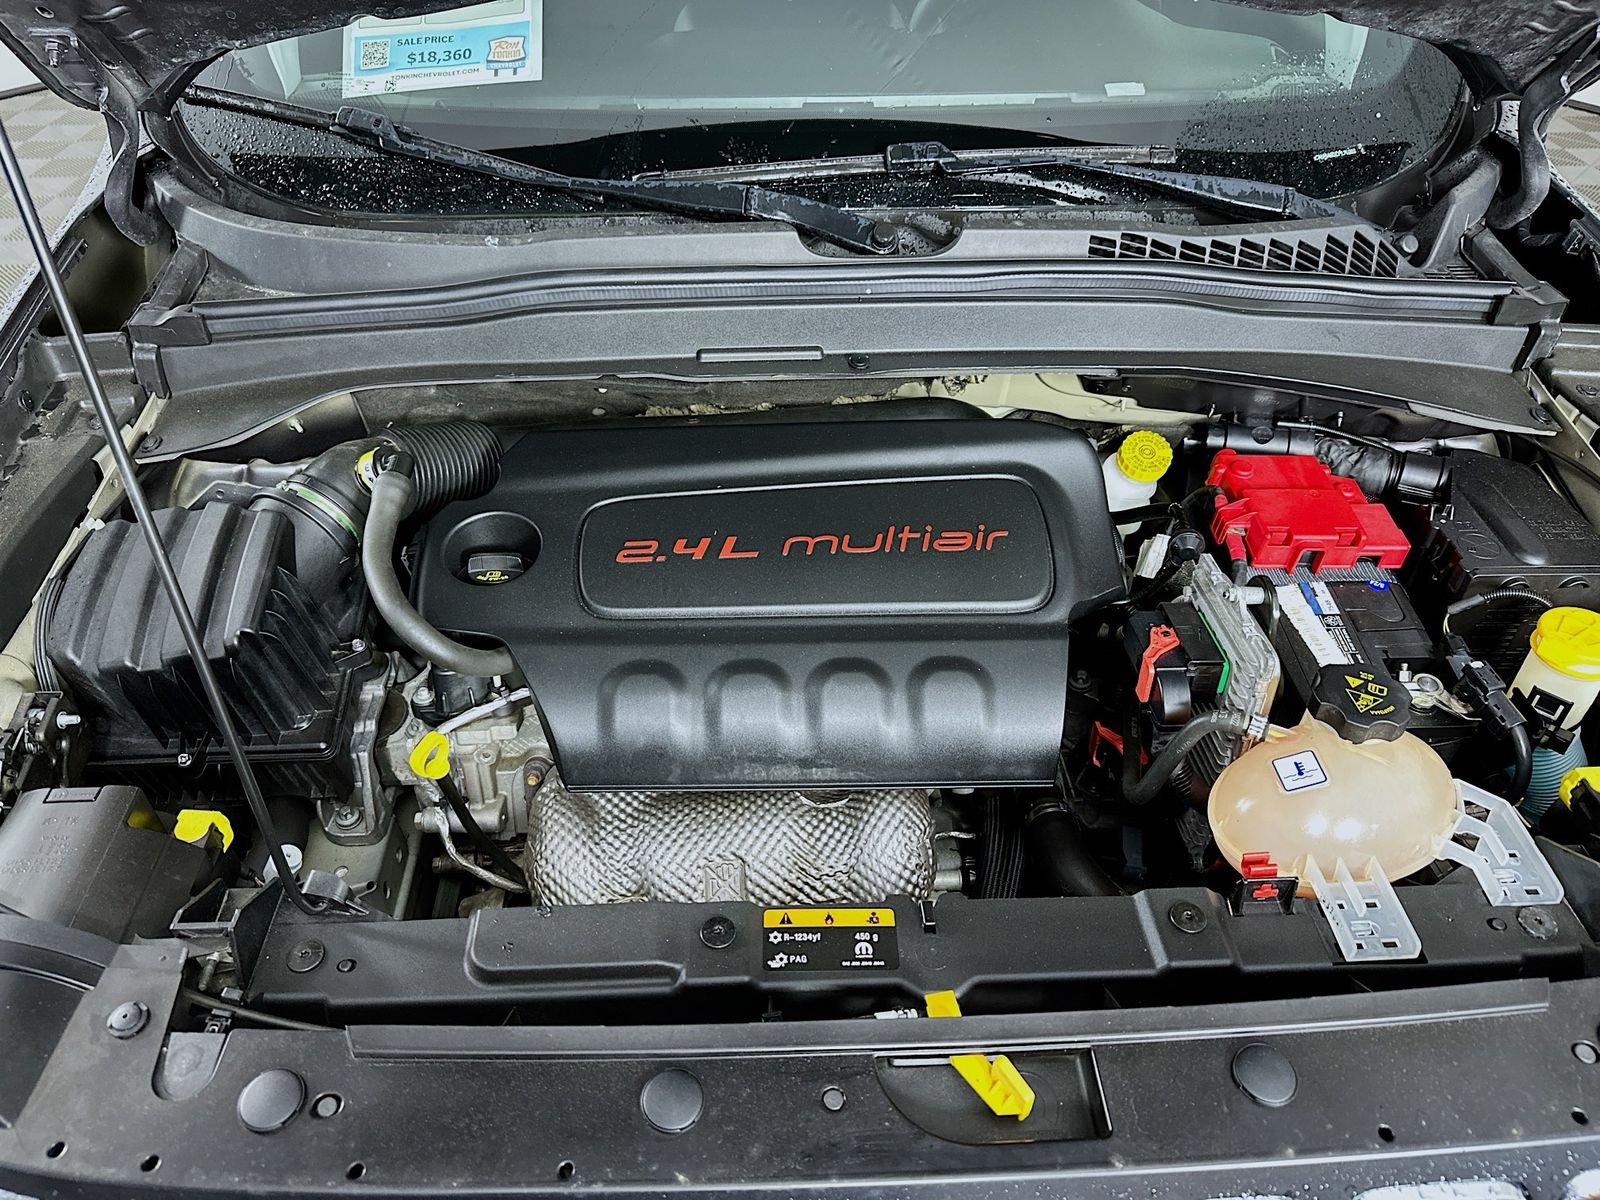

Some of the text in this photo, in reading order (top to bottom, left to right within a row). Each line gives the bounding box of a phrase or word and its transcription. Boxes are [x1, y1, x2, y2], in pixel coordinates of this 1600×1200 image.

[396, 35, 455, 47] SALE PRICE
[407, 48, 472, 66] $18,360
[615, 524, 1009, 563] 2.4L multiair
[783, 932, 879, 943] R-1234yf 450 g
[789, 955, 808, 964] PAG
